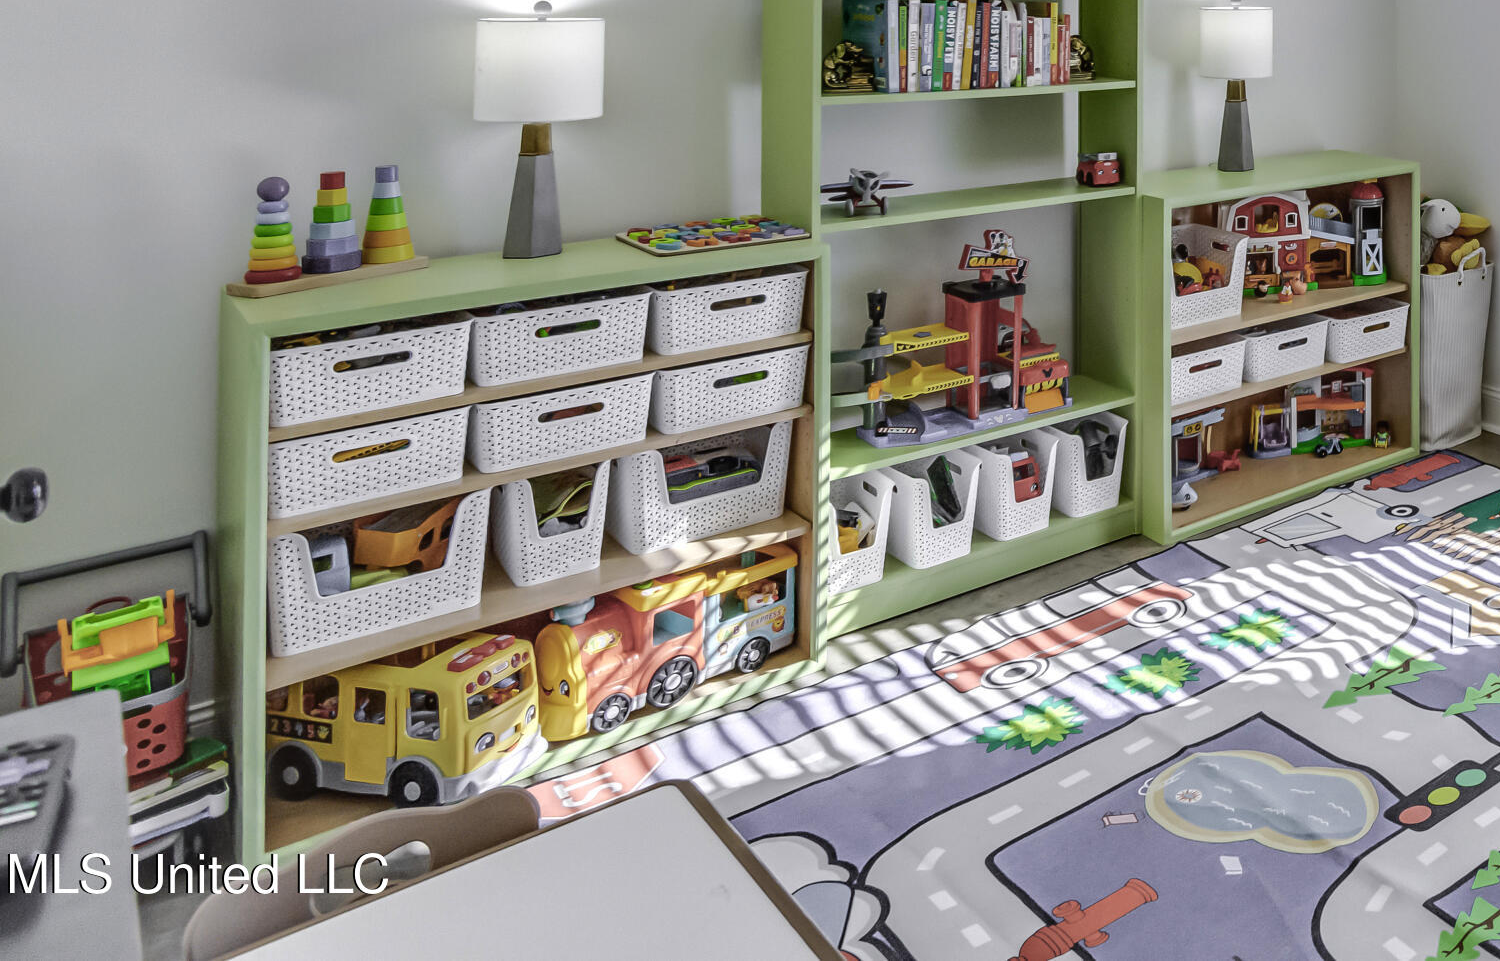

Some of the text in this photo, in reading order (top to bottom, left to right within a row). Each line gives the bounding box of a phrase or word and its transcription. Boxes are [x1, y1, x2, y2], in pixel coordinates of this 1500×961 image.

[946, 10, 956, 38] NOISY
[989, 9, 1000, 68] NOISY FARM
[909, 30, 918, 62] Garden
[969, 256, 1017, 268] GARAGE
